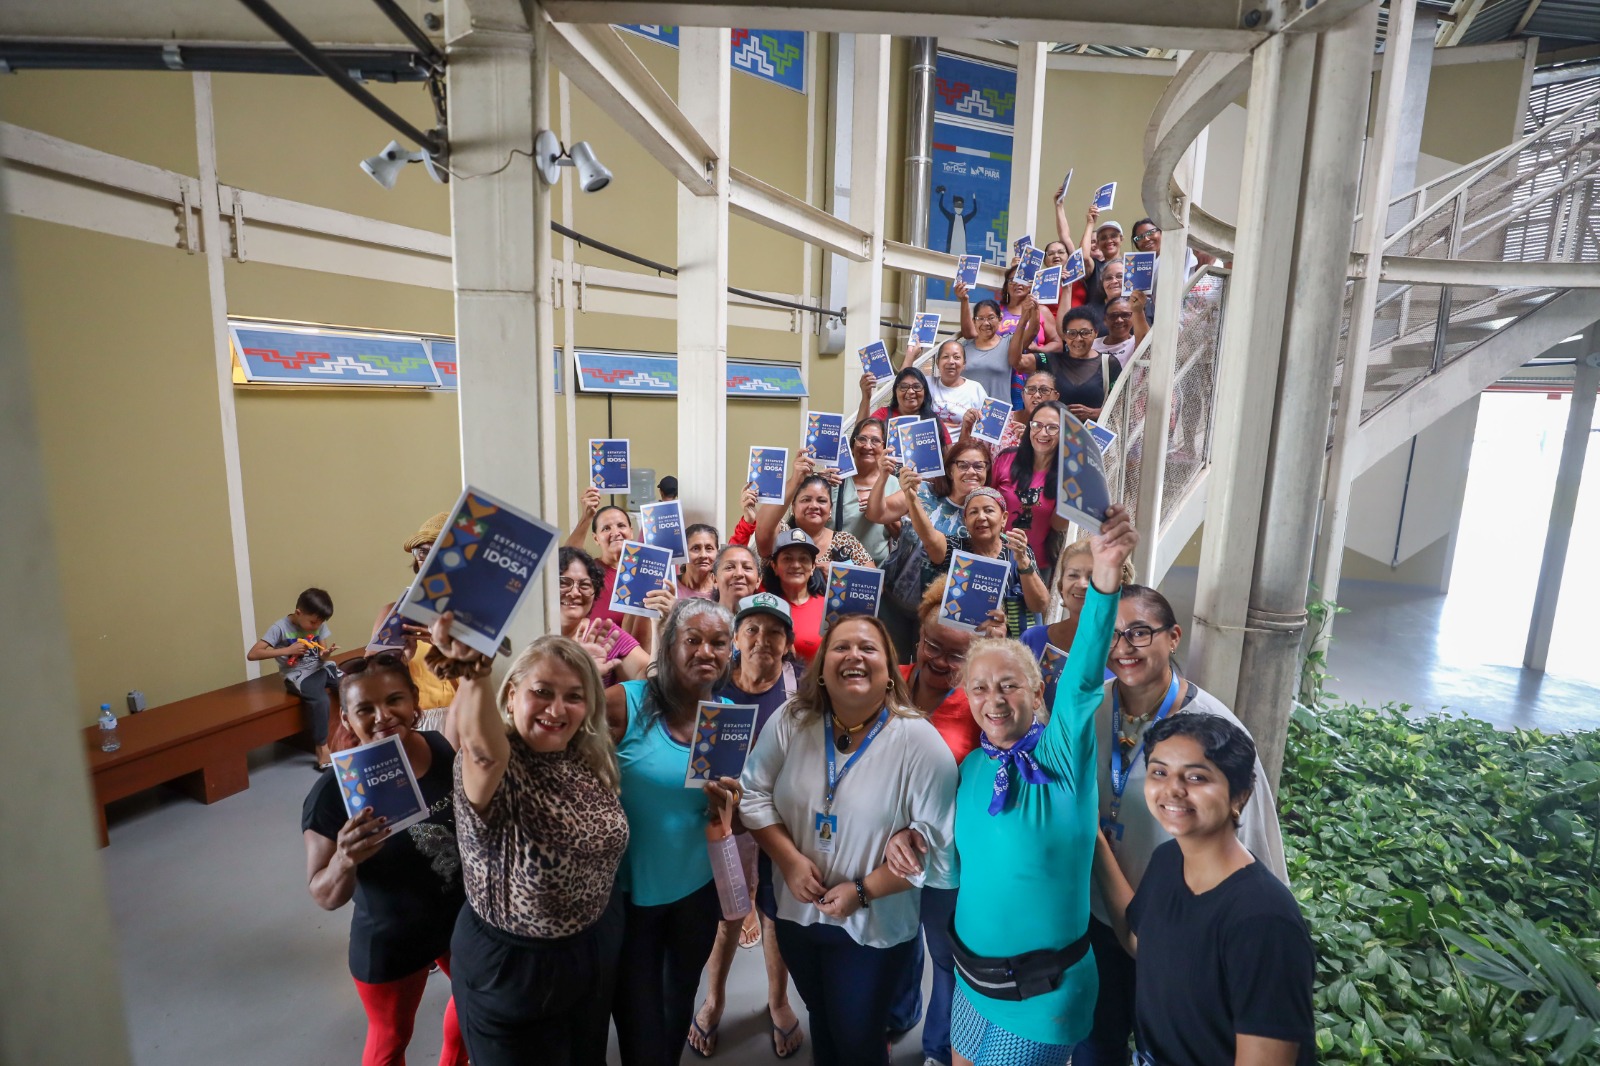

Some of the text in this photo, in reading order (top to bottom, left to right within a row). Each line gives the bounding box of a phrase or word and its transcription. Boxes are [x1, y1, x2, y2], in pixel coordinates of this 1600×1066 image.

[916, 438, 936, 446] IDOSA
[494, 534, 538, 560] ESTATUTO
[483, 548, 528, 579] IDOSA
[640, 567, 663, 577] IDOSA
[975, 574, 1002, 583] ESTATUTO
[972, 582, 998, 595] IDOSA
[850, 592, 875, 601] IDOSA
[364, 757, 399, 773] ESTATUTO
[367, 768, 404, 787] IDOSA
